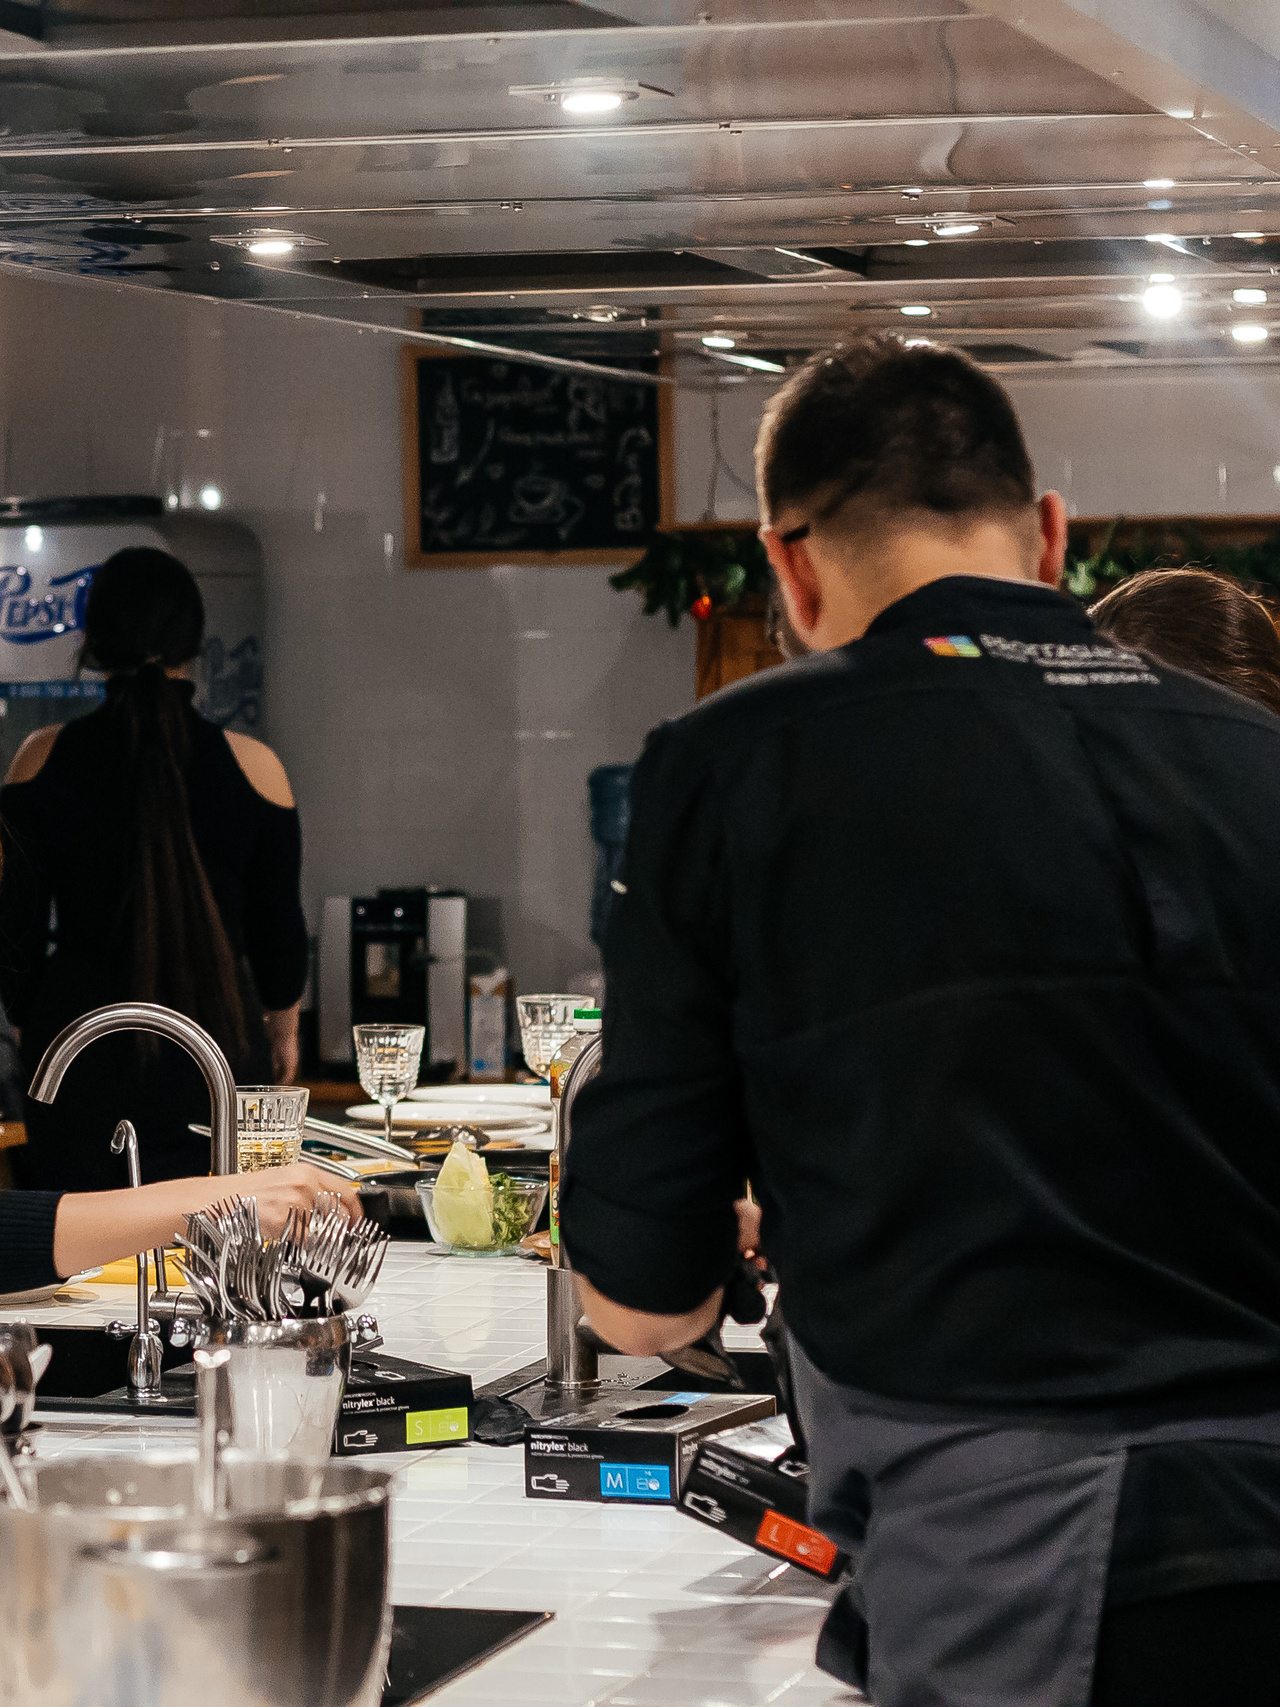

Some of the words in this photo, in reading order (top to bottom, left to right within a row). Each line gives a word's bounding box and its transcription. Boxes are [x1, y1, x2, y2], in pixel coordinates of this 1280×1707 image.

[342, 1399, 374, 1411] nitrylex
[376, 1396, 395, 1407] black
[414, 1420, 424, 1436] S
[530, 1440, 566, 1453] nitrylex
[568, 1442, 589, 1452] black
[606, 1472, 623, 1489] M
